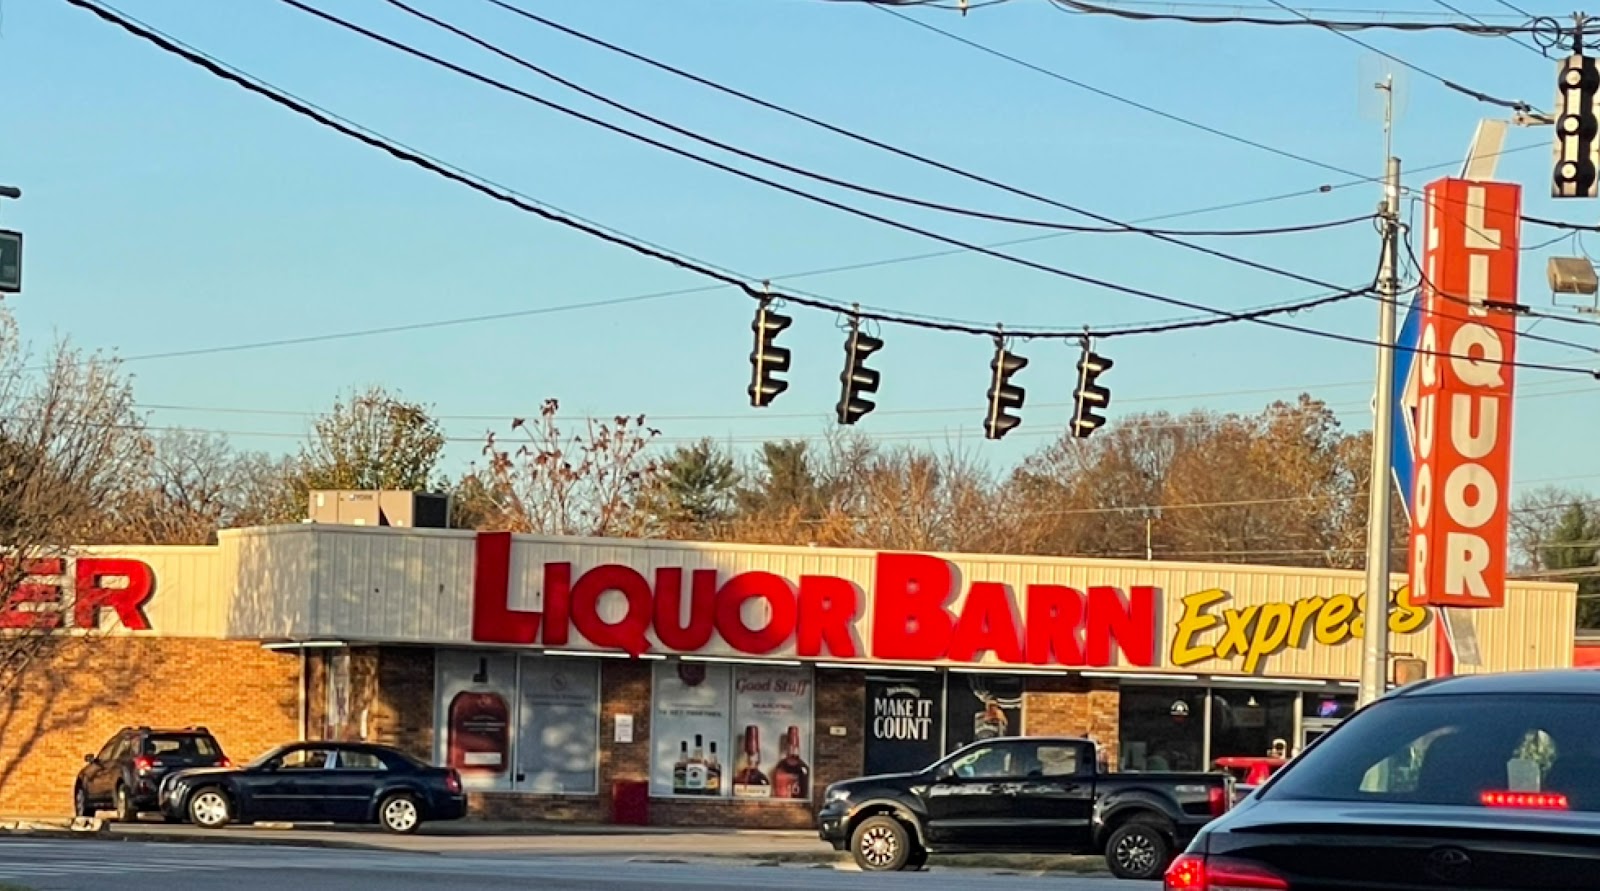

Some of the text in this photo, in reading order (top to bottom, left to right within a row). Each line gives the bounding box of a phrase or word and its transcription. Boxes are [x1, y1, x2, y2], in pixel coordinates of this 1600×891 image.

[1412, 188, 1439, 598] LIQUOR
[1444, 186, 1504, 598] LIQUOR
[735, 678, 811, 697] Good Stuff
[874, 697, 933, 718] MAKE IT
[873, 717, 932, 740] COUNT
